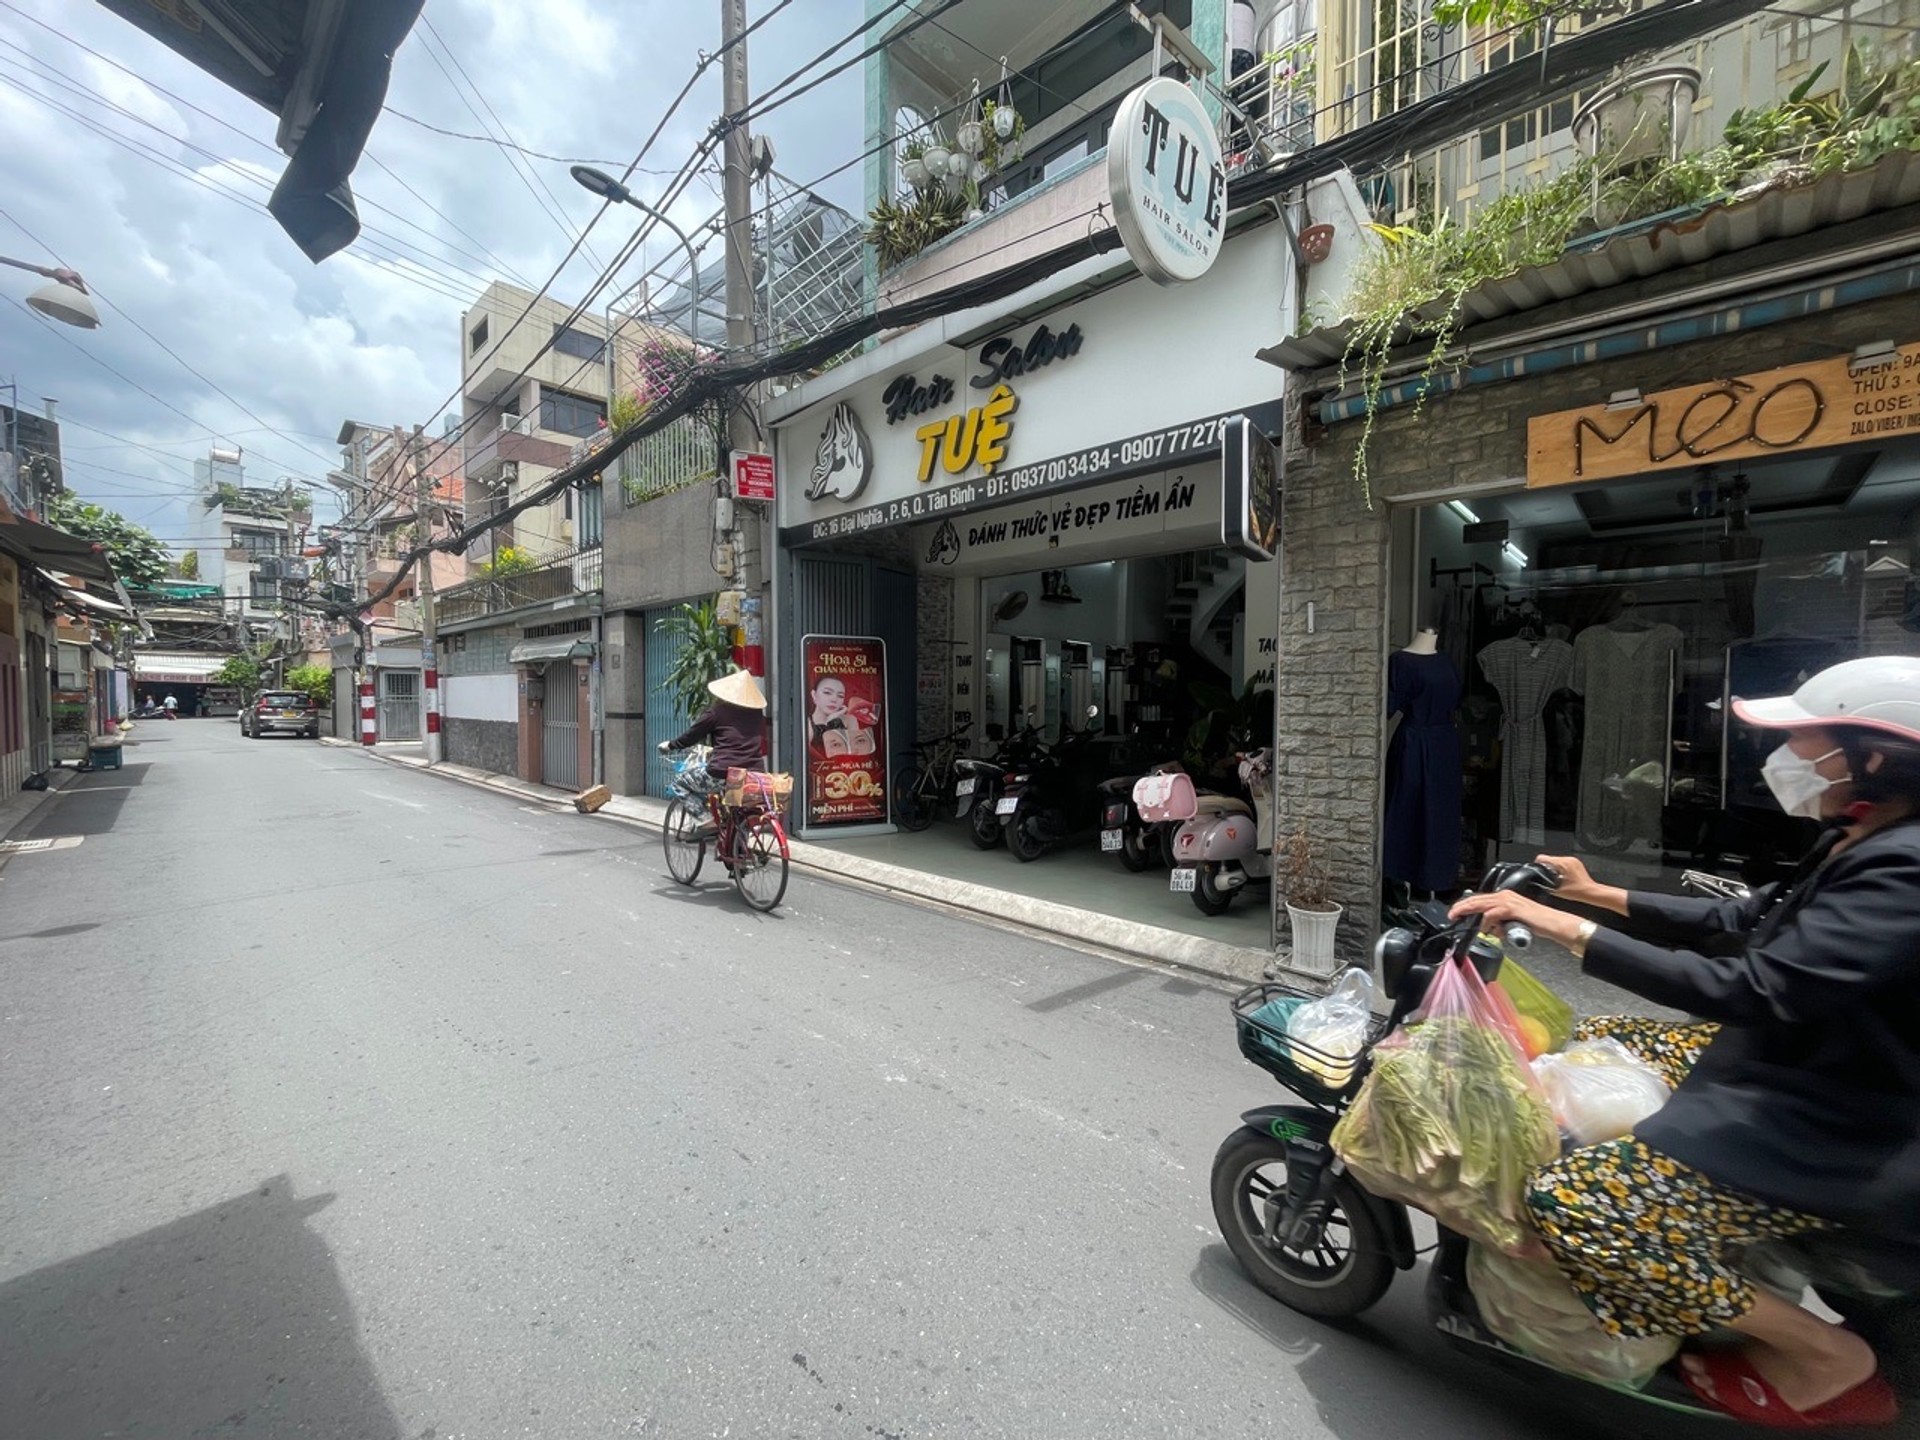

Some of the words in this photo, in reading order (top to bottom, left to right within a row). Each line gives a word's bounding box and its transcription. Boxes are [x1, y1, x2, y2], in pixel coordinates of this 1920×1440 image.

[1142, 195, 1171, 225] HAIR
[1176, 223, 1210, 257] SALON
[882, 373, 955, 425] Hair
[969, 322, 1084, 389] Salon
[1854, 374, 1888, 394] THỨ
[1891, 375, 1901, 389] 3
[915, 384, 1018, 482] TUỆ
[1854, 395, 1912, 416] CLOSE:
[840, 515, 856, 534] Đại
[857, 507, 882, 530] Nghĩa
[890, 503, 900, 522] P.
[913, 496, 925, 514] Q.
[927, 491, 947, 511] Tân
[950, 484, 975, 506] Bình
[986, 475, 1009, 497] ĐT:
[968, 521, 1007, 546] ĐÁNH
[1011, 509, 1048, 539] THỨC
[1074, 501, 1111, 531] ĐẸP
[1116, 484, 1160, 520] TIỀM
[1165, 475, 1196, 511] ẨN
